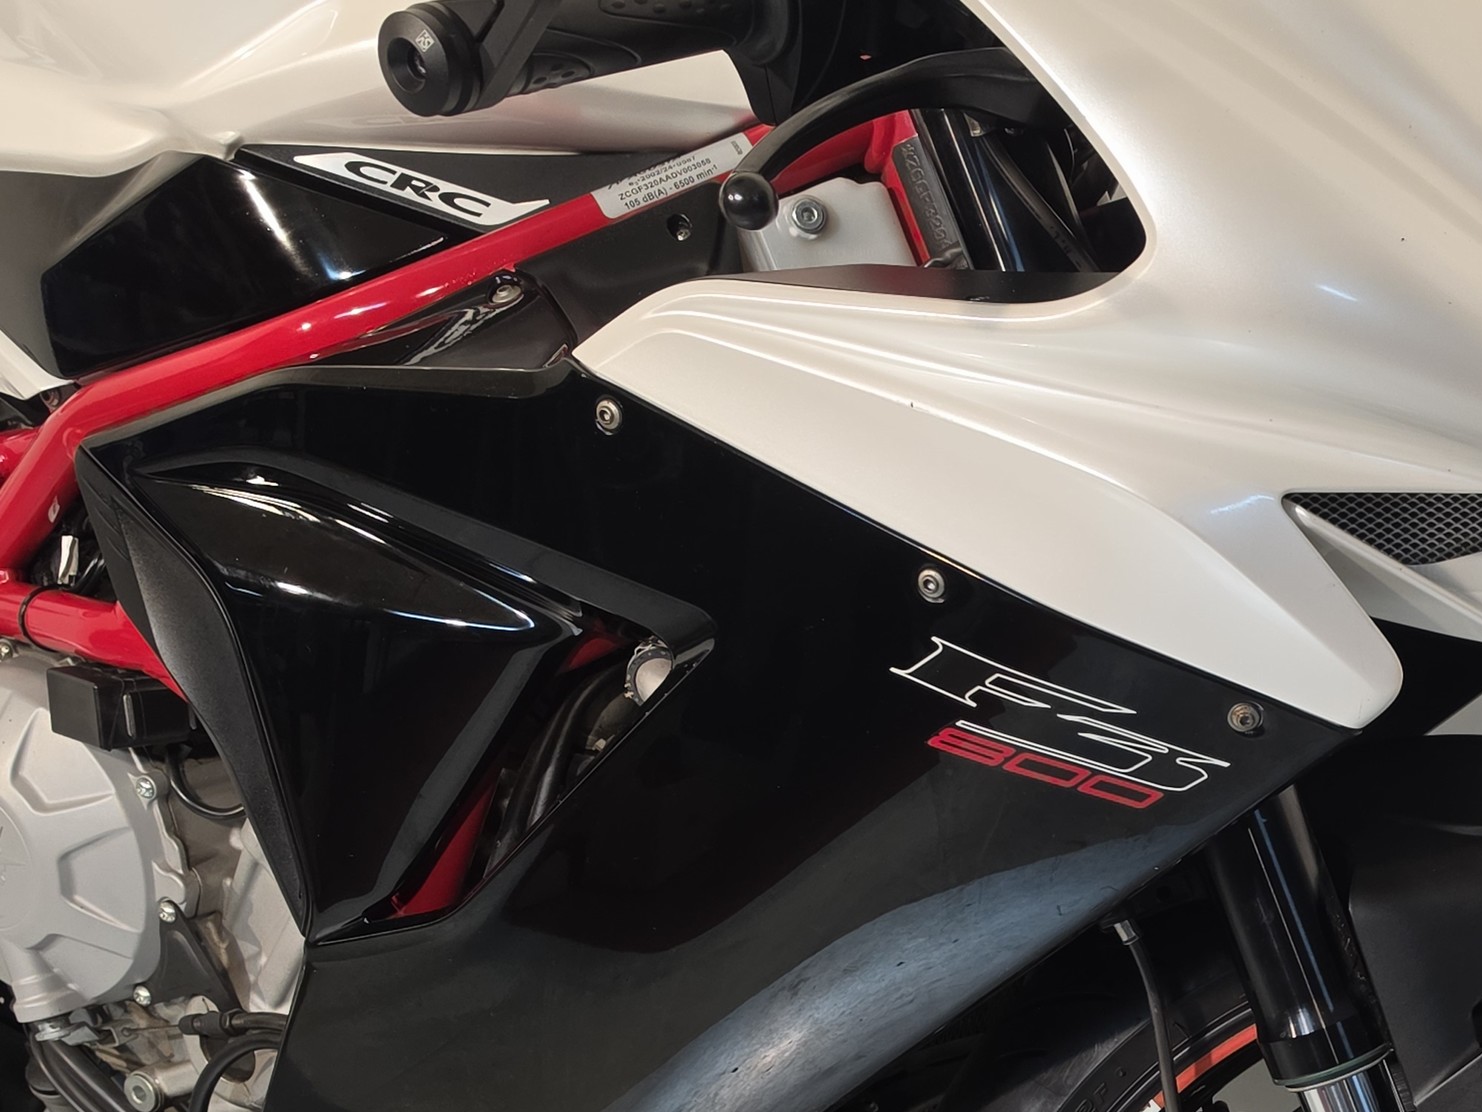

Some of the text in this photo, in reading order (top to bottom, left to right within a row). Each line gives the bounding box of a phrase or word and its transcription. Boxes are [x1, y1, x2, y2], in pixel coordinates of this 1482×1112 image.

[344, 160, 492, 218] CRC
[624, 198, 640, 210] 105
[641, 186, 668, 204] dB(A)
[673, 175, 695, 191] 6500
[889, 636, 1231, 792] F3
[927, 727, 1164, 809] 800
